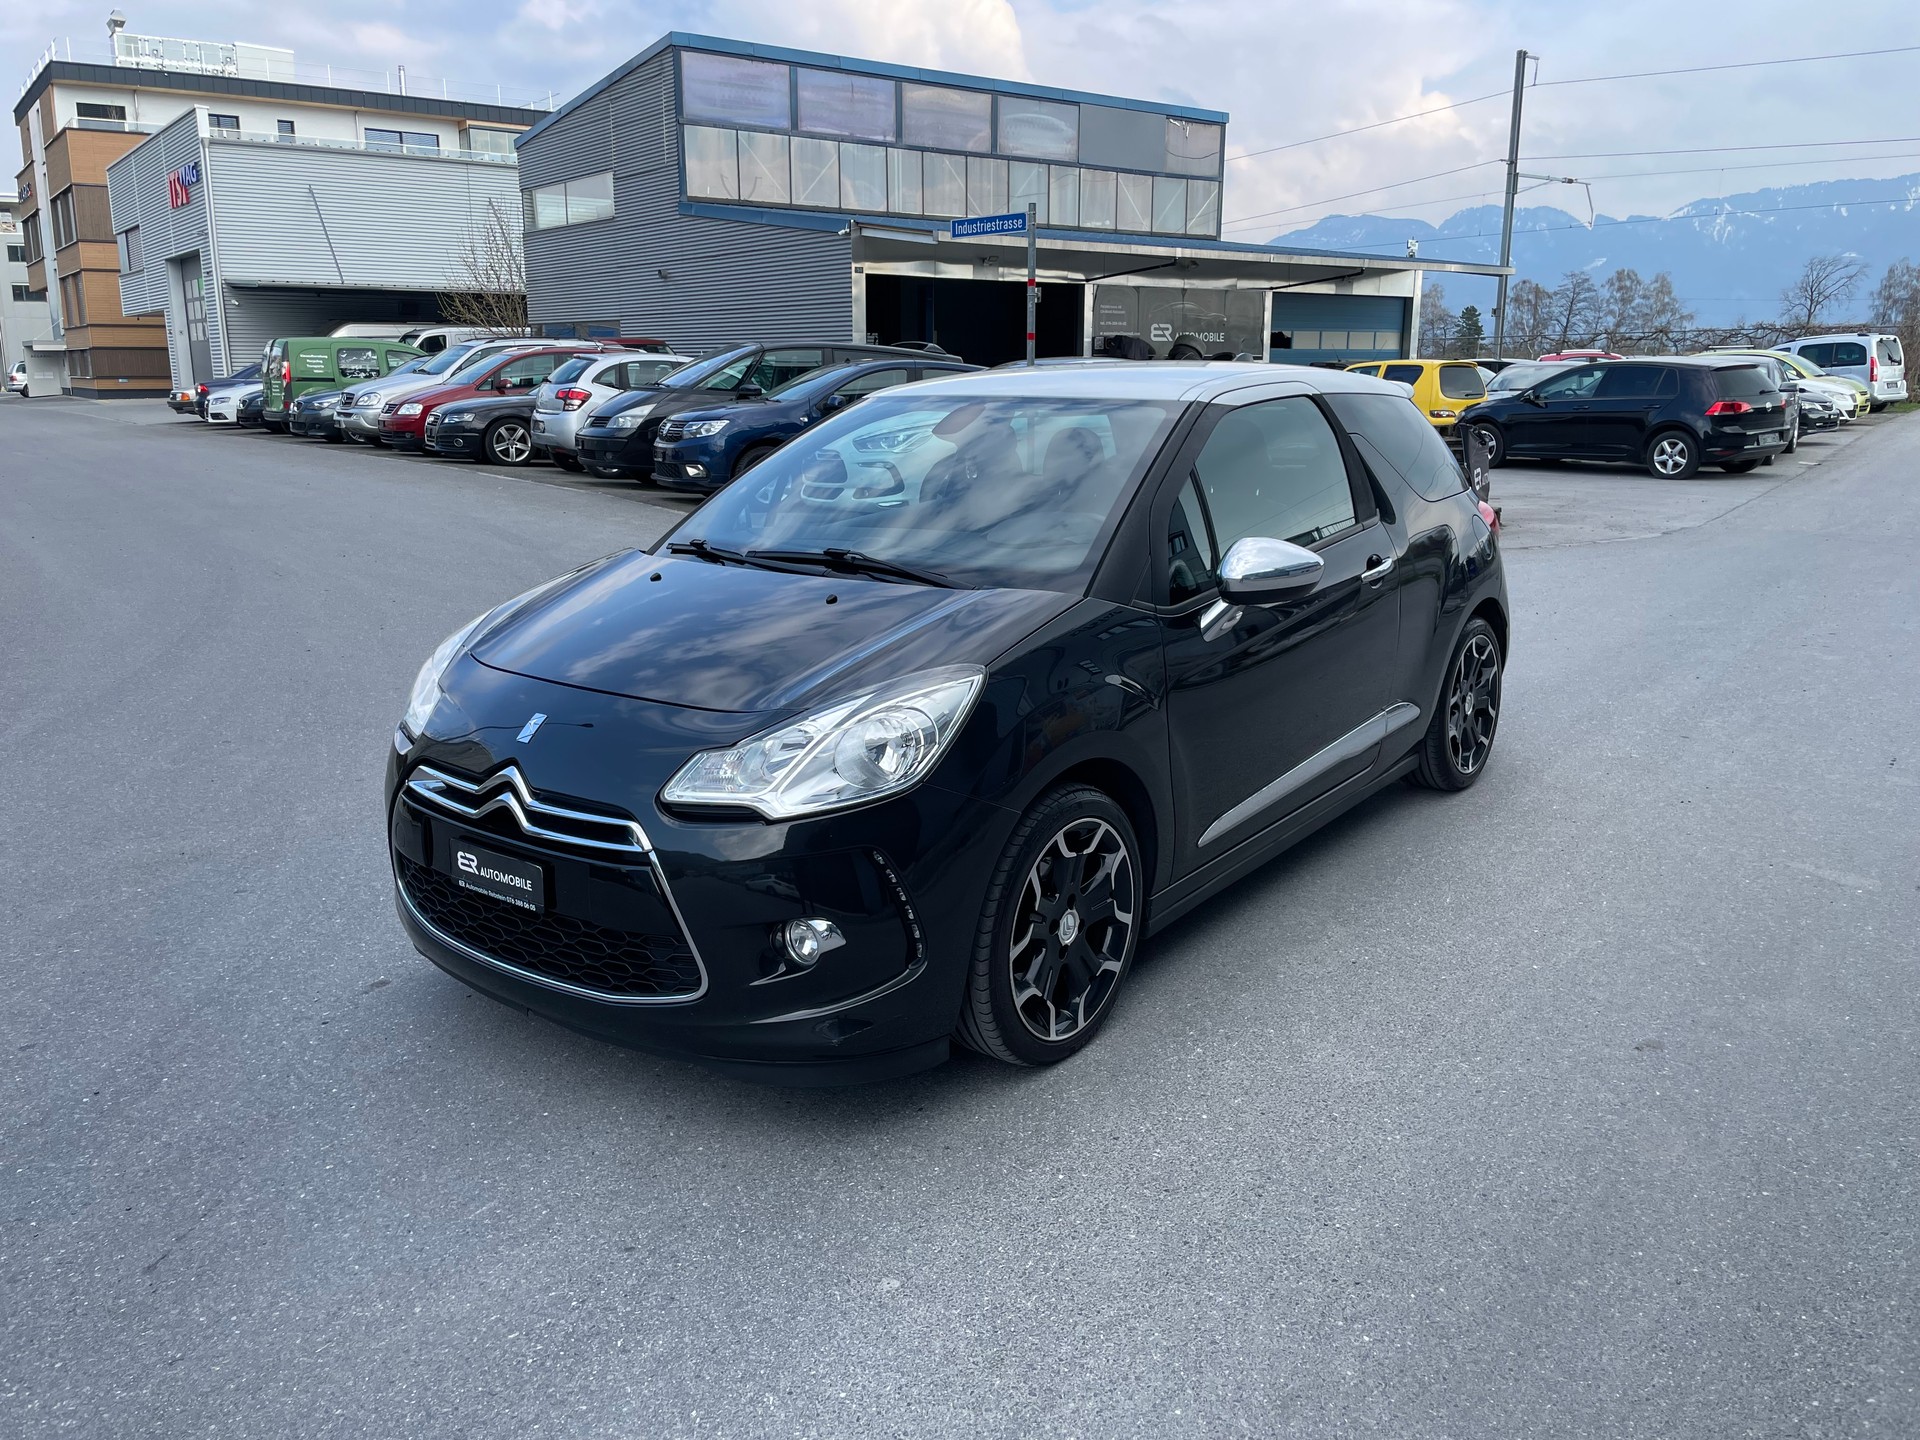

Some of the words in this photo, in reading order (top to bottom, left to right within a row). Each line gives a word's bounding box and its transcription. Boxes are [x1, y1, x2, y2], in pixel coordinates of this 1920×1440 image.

[955, 218, 1023, 235] Industriestrasse
[480, 866, 533, 892] AUTOMOBILE
[466, 882, 489, 896] Automobile
